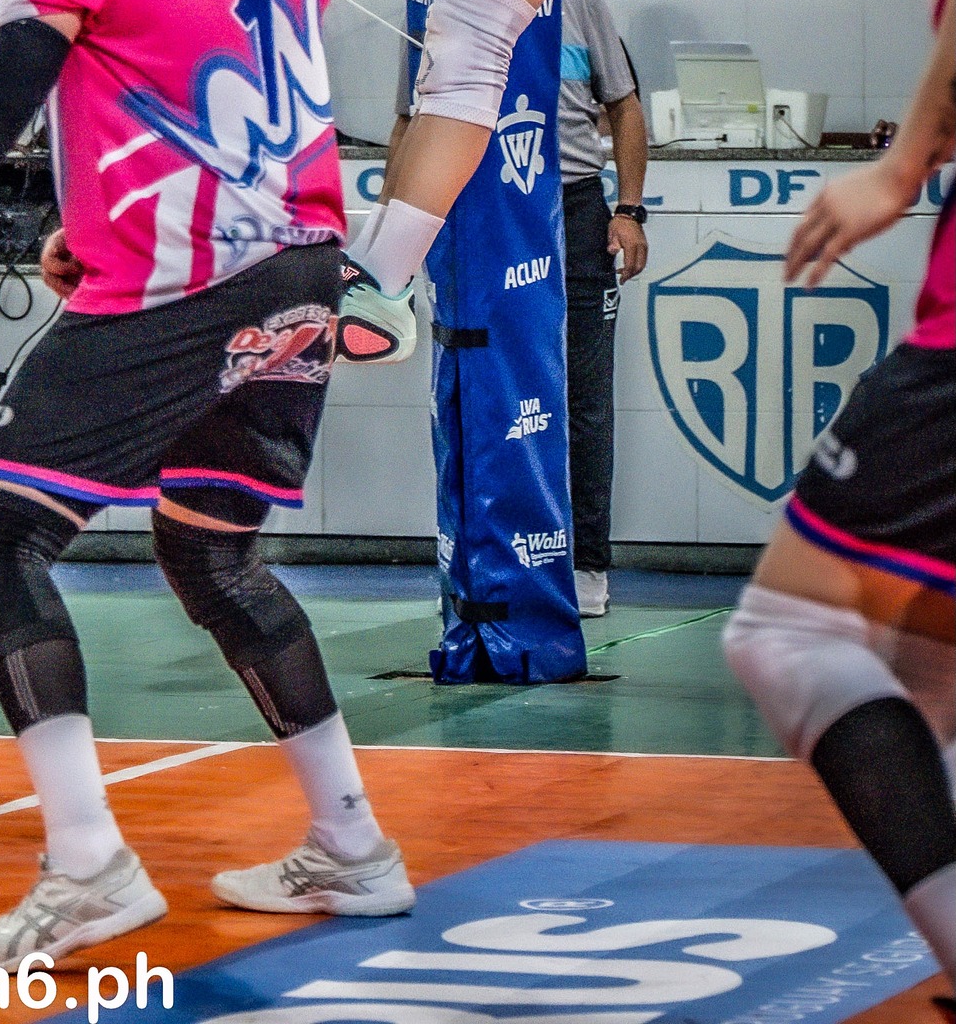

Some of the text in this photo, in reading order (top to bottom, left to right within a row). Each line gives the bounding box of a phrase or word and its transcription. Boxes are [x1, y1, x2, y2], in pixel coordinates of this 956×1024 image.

[504, 255, 552, 290] ACLAV
[519, 397, 542, 417] LVA
[521, 413, 552, 436] RUS
